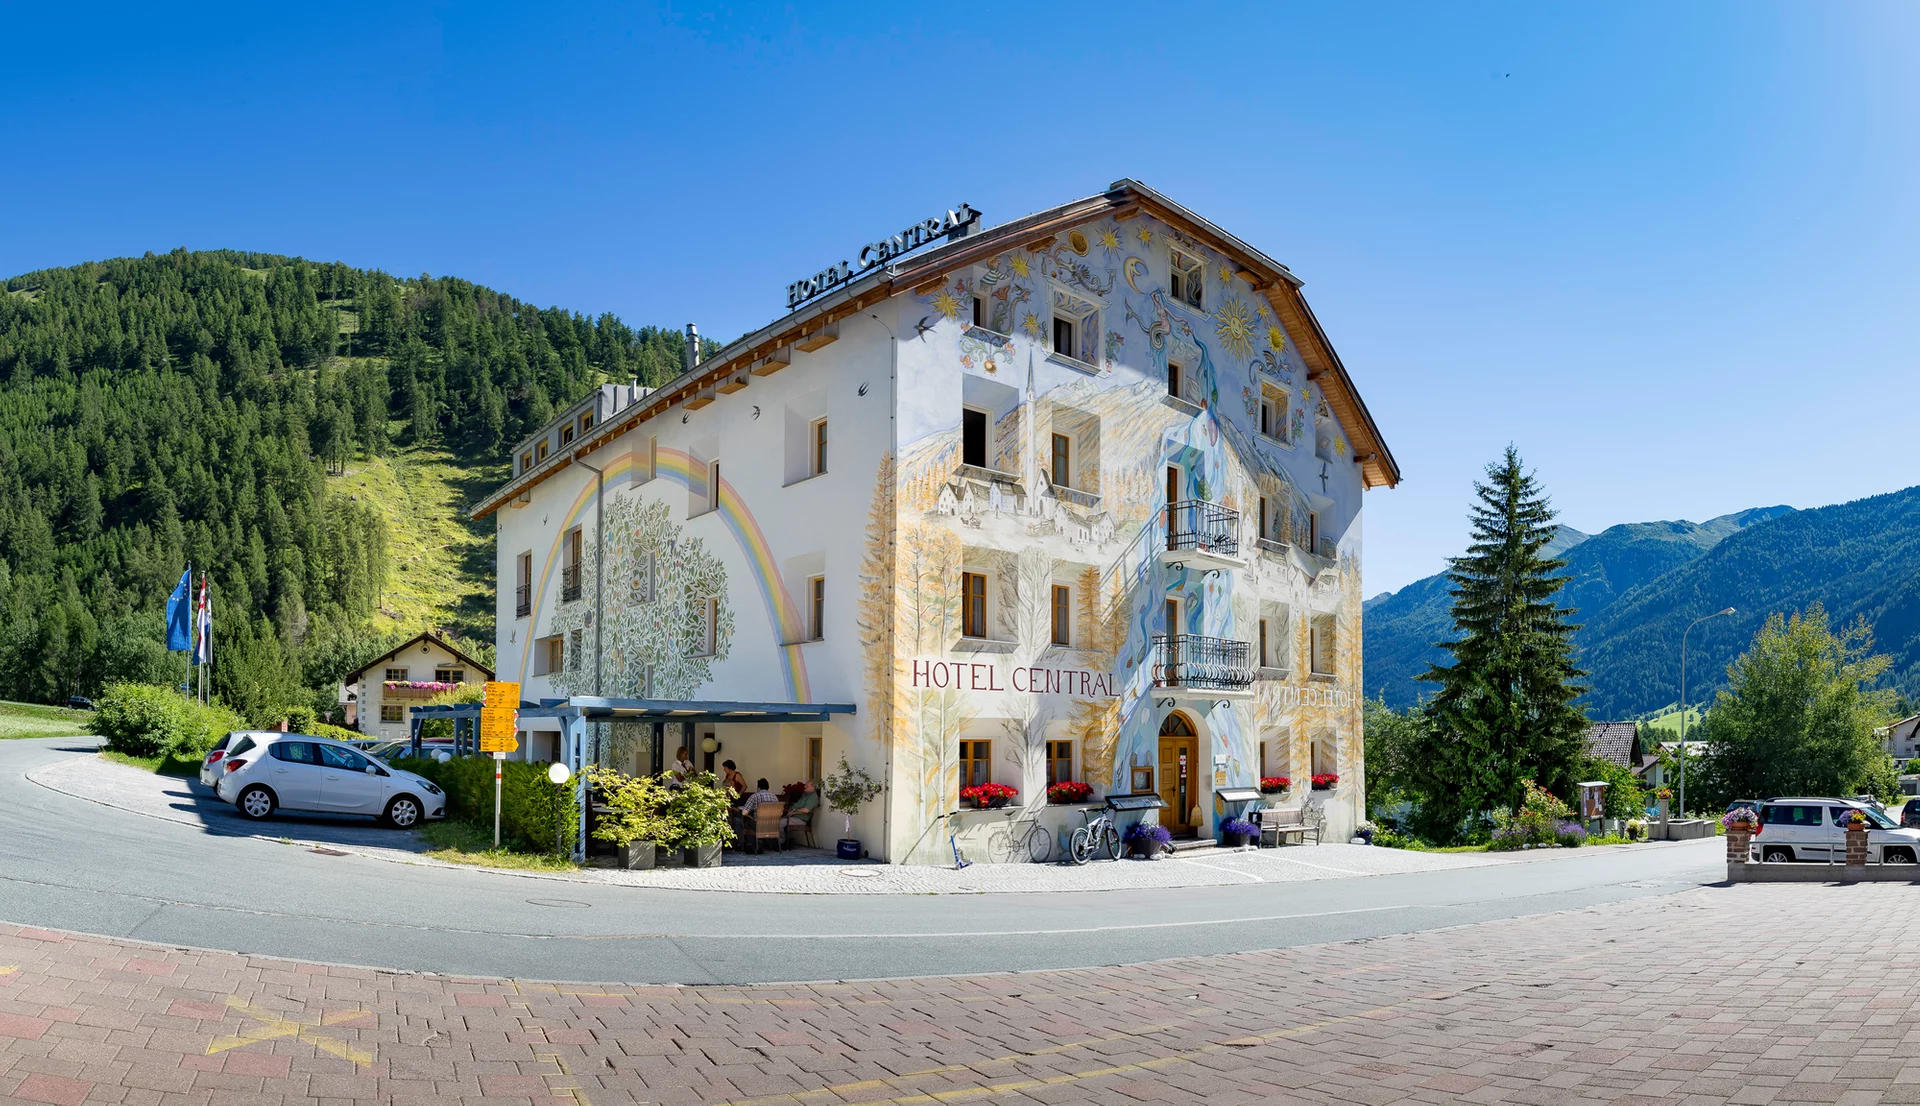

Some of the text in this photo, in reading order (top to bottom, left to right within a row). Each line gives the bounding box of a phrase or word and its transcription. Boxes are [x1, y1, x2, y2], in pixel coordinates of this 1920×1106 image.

[786, 202, 976, 308] HOTEL CENTRAL
[912, 659, 1120, 698] HOTEL CENTRAL
